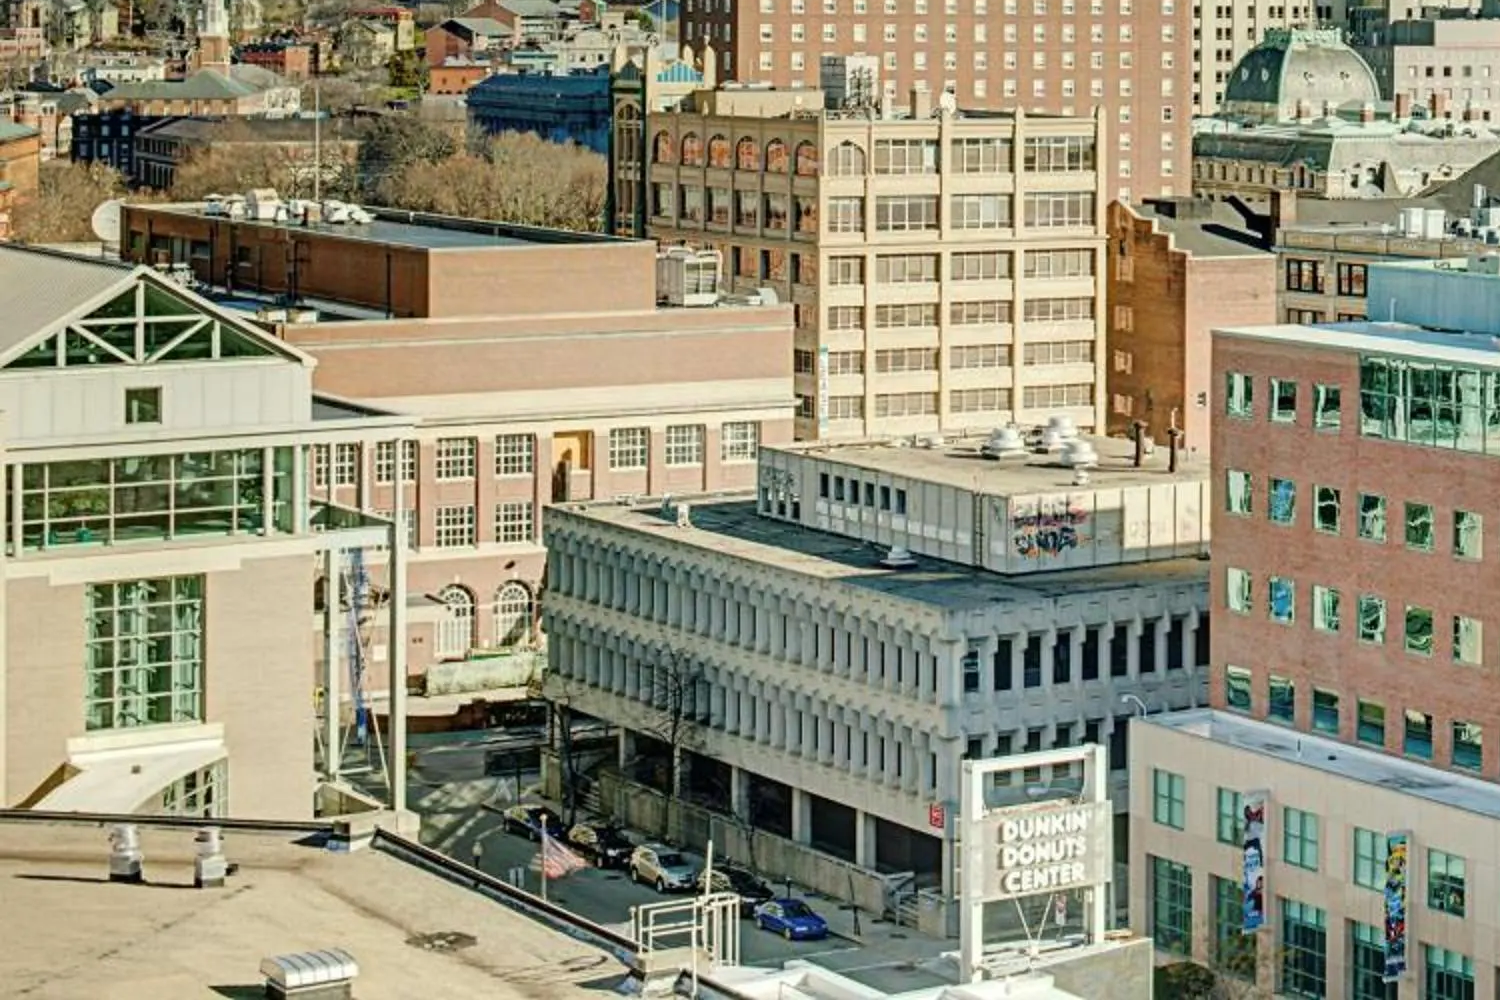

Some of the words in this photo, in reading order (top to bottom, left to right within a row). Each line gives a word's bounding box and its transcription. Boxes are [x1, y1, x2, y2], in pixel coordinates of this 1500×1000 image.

[1003, 809, 1092, 841] DUNKIN'
[1003, 837, 1086, 867] DONUTS
[1004, 862, 1086, 893] CENTER
